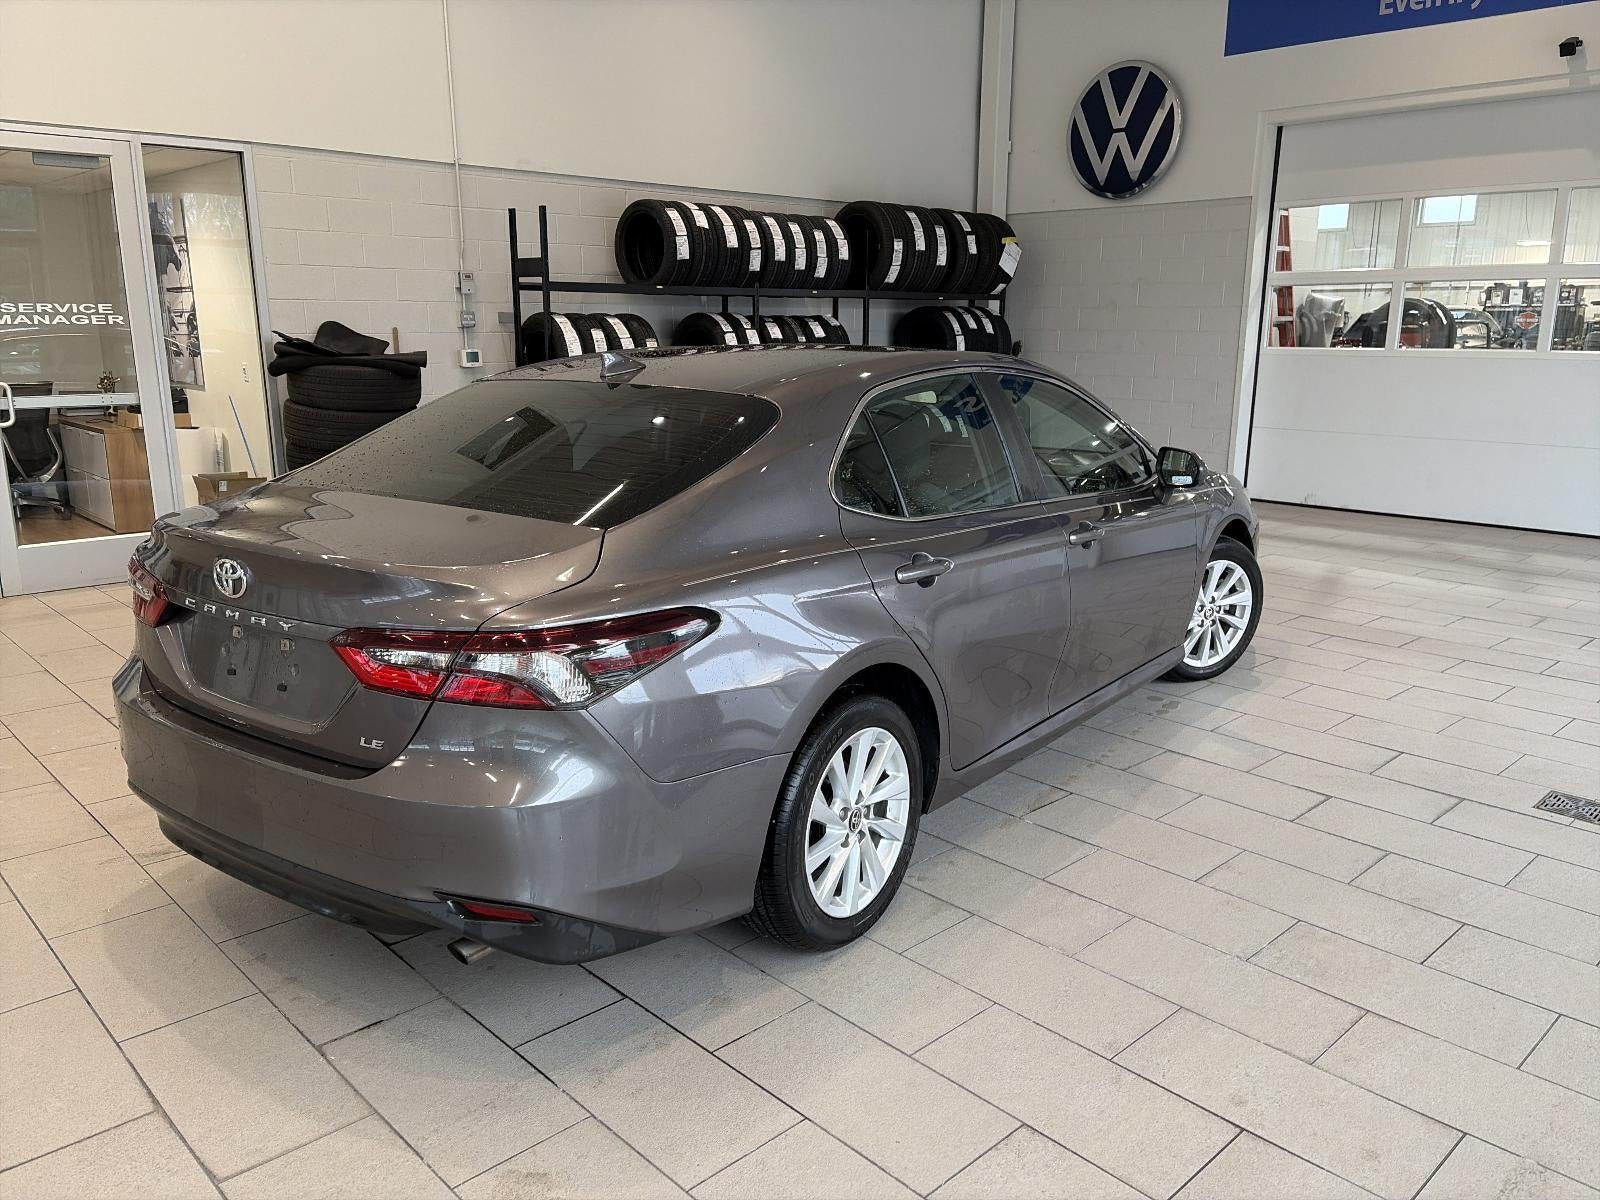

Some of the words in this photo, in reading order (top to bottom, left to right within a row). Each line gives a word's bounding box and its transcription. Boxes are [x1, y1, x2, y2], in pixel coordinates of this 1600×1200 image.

[1069, 63, 1178, 188] VW
[0, 302, 114, 313] SERVICE
[184, 597, 297, 632] CAMRY
[359, 736, 385, 750] LE
